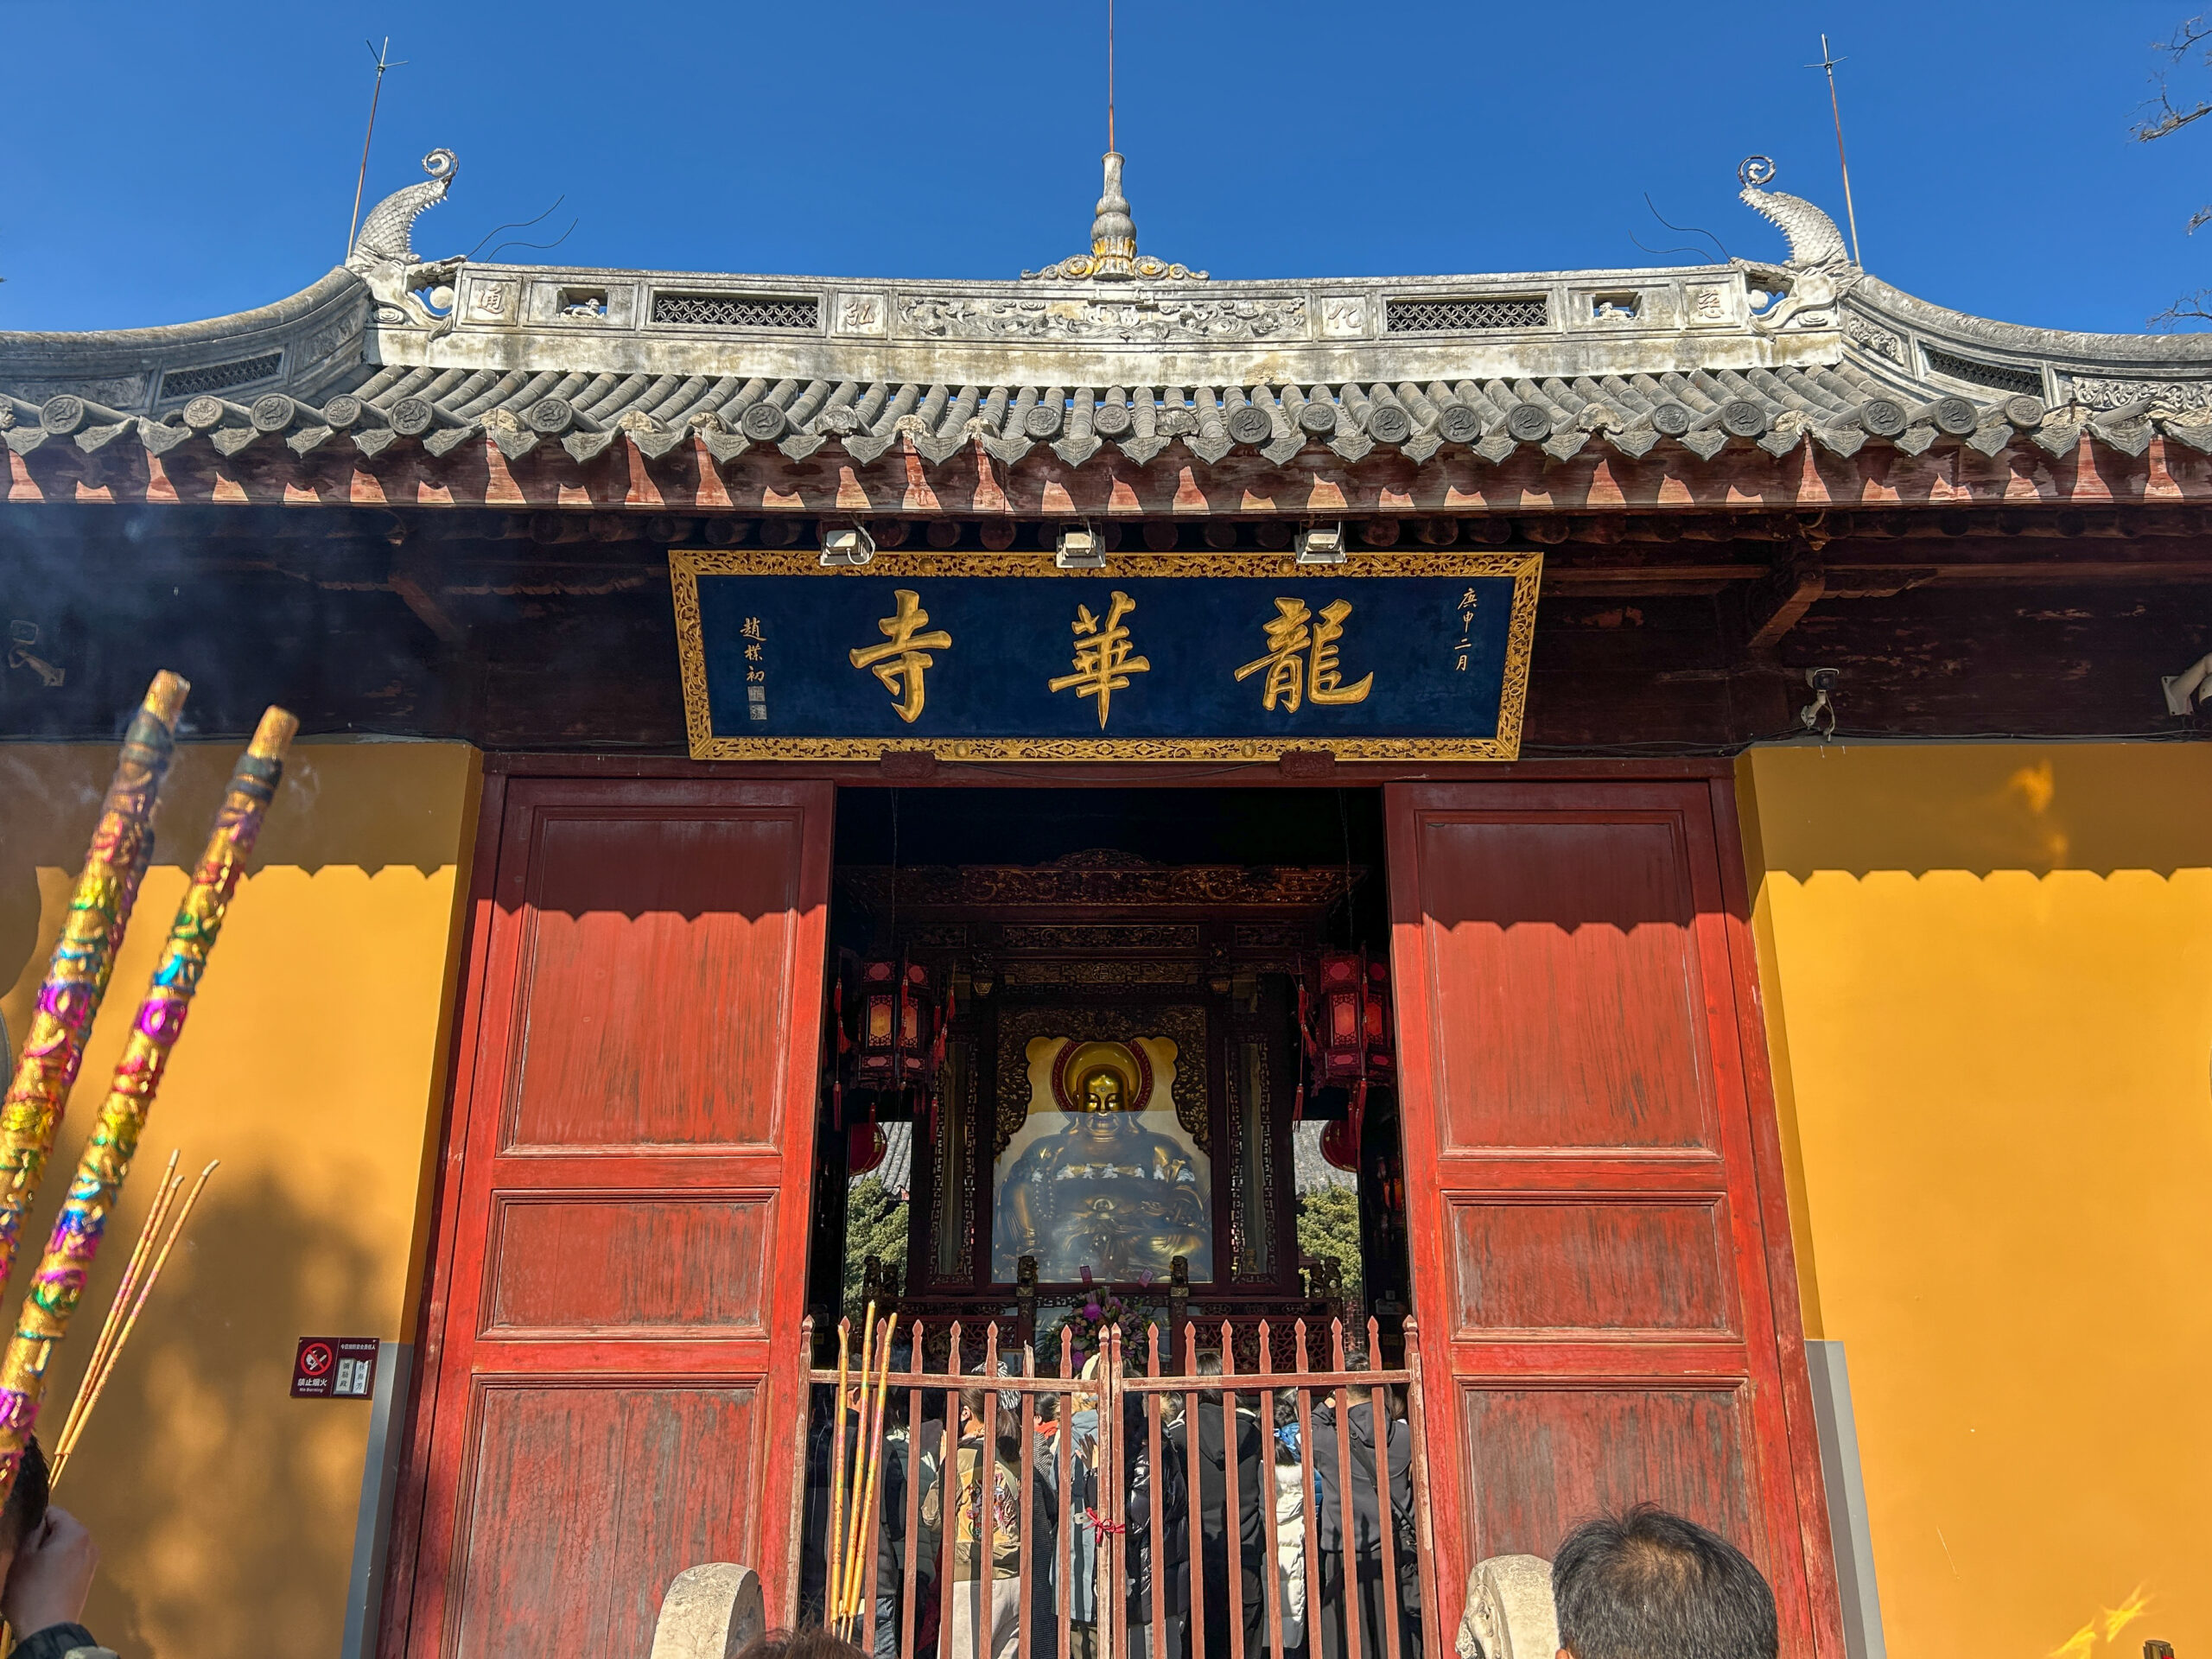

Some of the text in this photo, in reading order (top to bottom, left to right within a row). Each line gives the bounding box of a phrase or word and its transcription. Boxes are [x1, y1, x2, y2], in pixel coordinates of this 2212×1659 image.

[476, 282, 505, 315] 通
[844, 301, 875, 327] 弘
[1698, 288, 1725, 319] 慈
[1327, 300, 1362, 329] 化
[1454, 588, 1478, 671] 庚申二月
[849, 588, 1374, 730] 龍華寺
[297, 1378, 327, 1387] 禁止烟火
